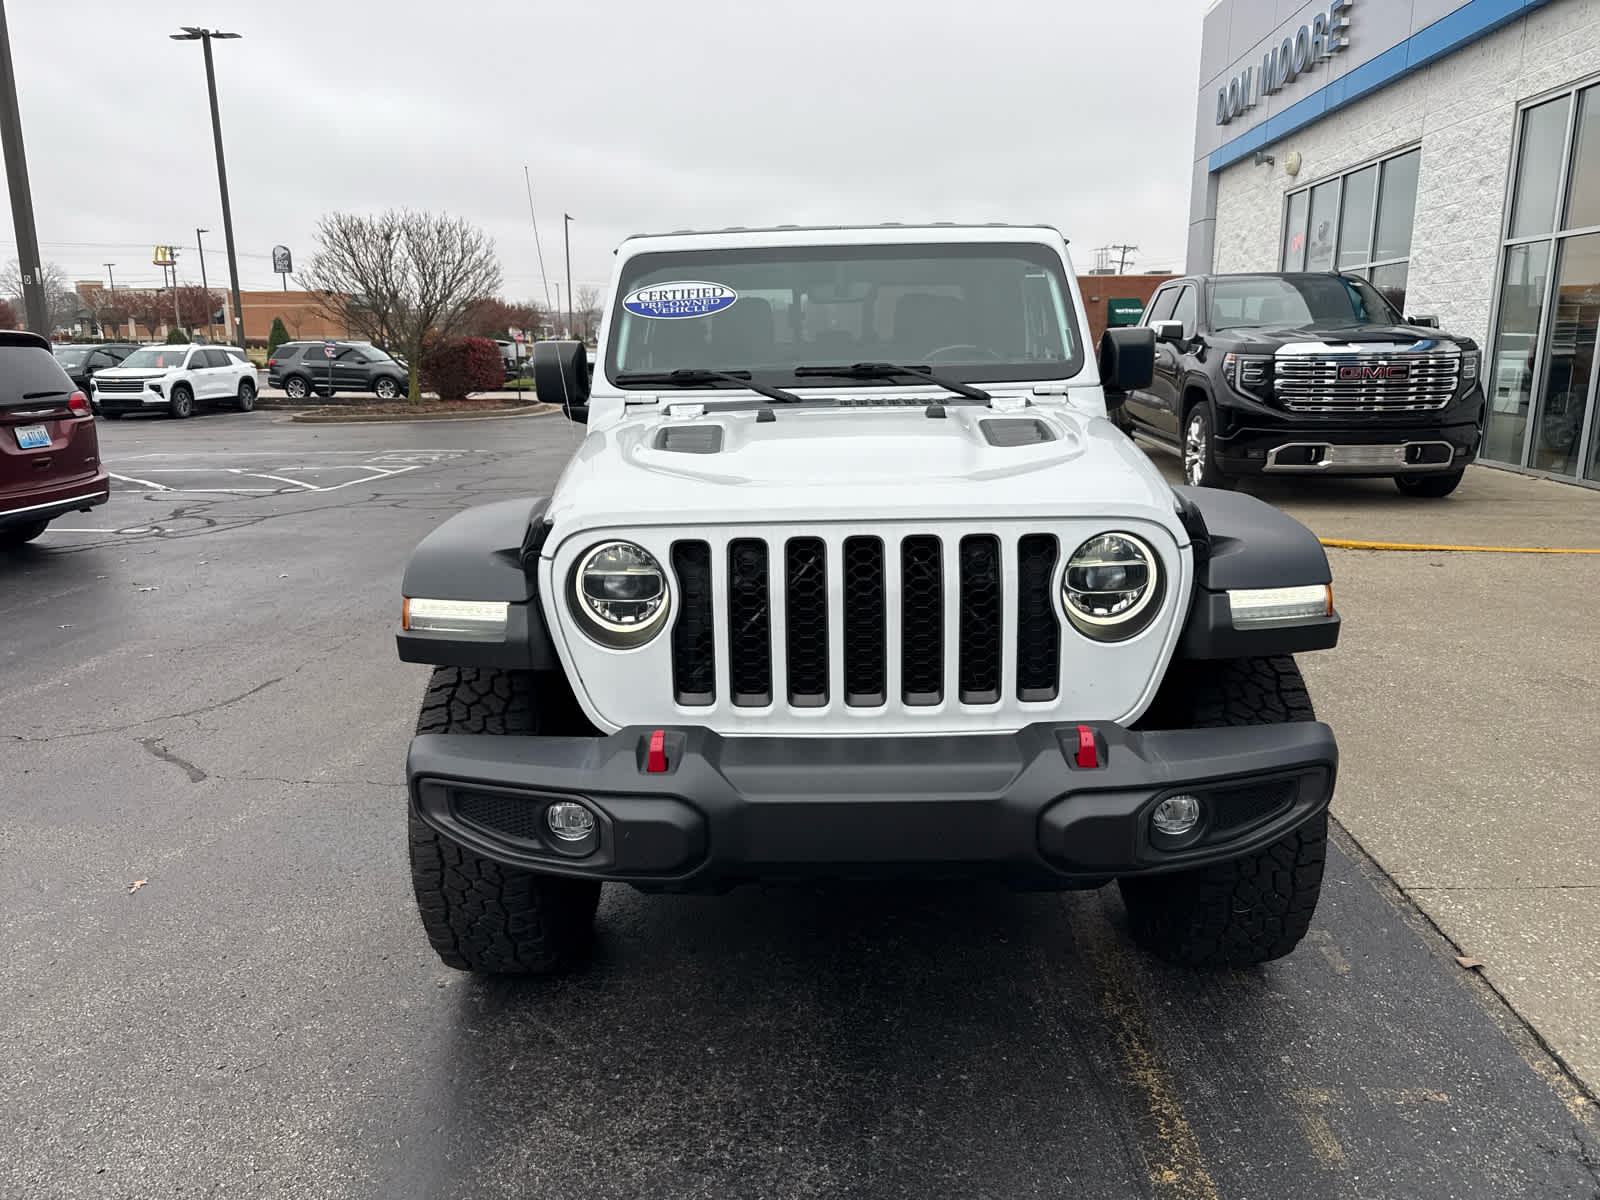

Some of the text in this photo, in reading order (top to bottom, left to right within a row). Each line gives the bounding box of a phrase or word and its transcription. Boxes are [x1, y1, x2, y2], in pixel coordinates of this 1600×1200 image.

[1216, 0, 1352, 125] DON MOORE
[636, 287, 725, 302] CERTIFIED
[641, 298, 721, 310] PRE-OWNED
[653, 304, 710, 315] VEHICLE
[1340, 366, 1408, 379] GMC
